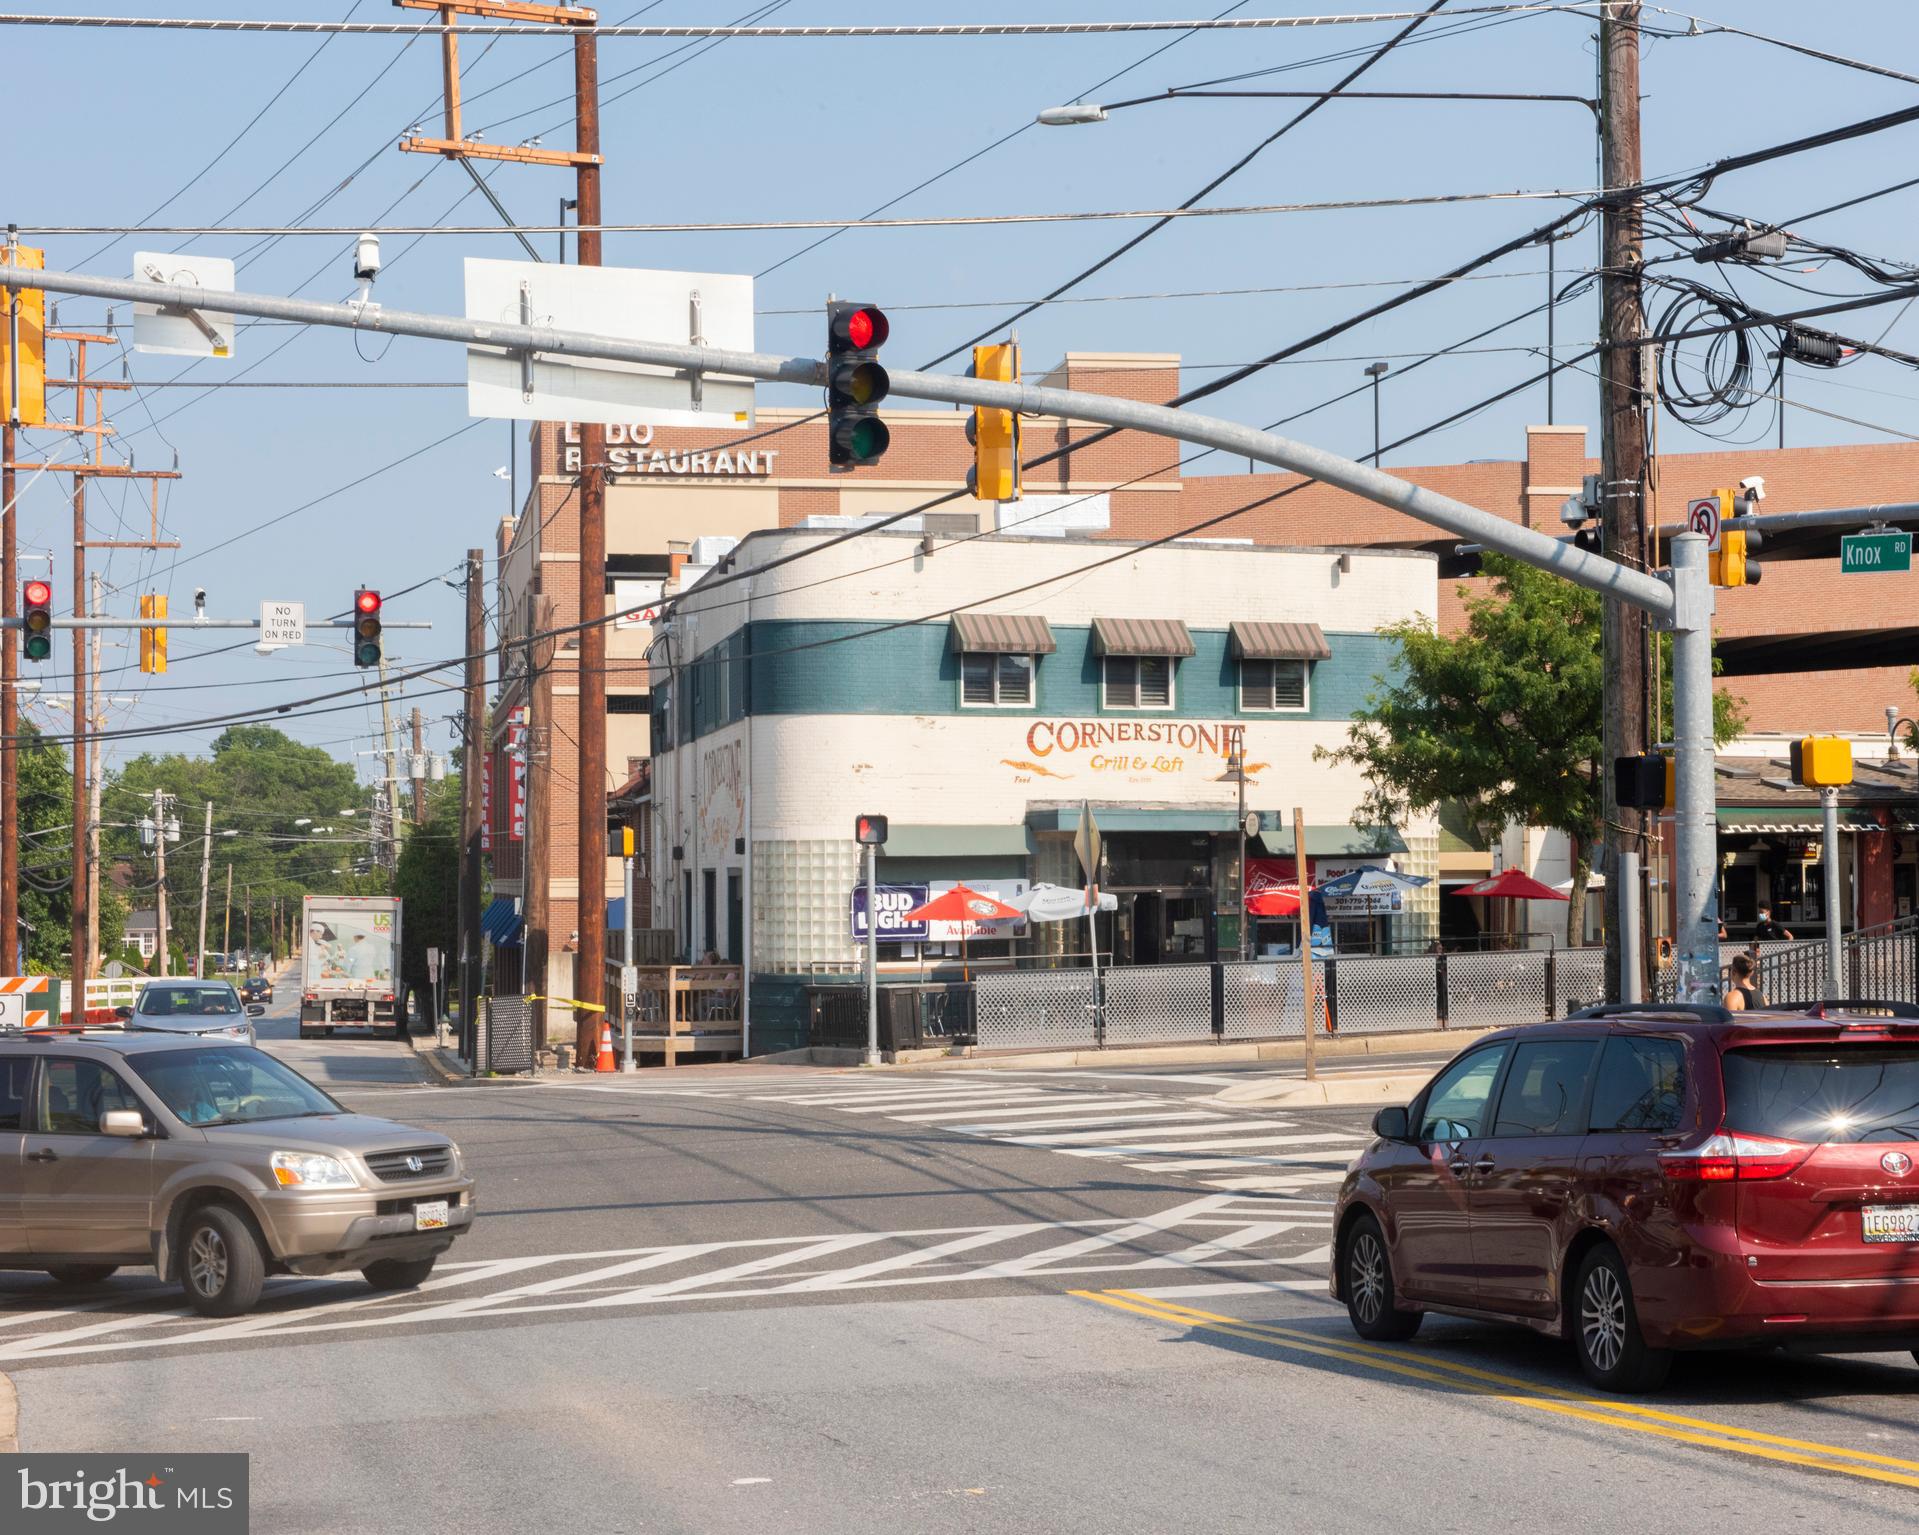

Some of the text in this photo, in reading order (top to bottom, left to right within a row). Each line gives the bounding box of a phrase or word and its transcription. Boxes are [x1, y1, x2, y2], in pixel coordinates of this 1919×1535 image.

[564, 422, 653, 445] LDO
[565, 447, 779, 474] RSTAURANT
[1846, 541, 1906, 565] Knox RD
[276, 607, 291, 615] NO
[271, 618, 296, 627] TURN
[265, 630, 301, 640] ON RED
[1026, 721, 1247, 759] CORNERSTONE
[1090, 755, 1184, 773] Grill & Loft
[1014, 776, 1031, 784] Food
[870, 893, 914, 911] BUD
[946, 925, 997, 935] Available
